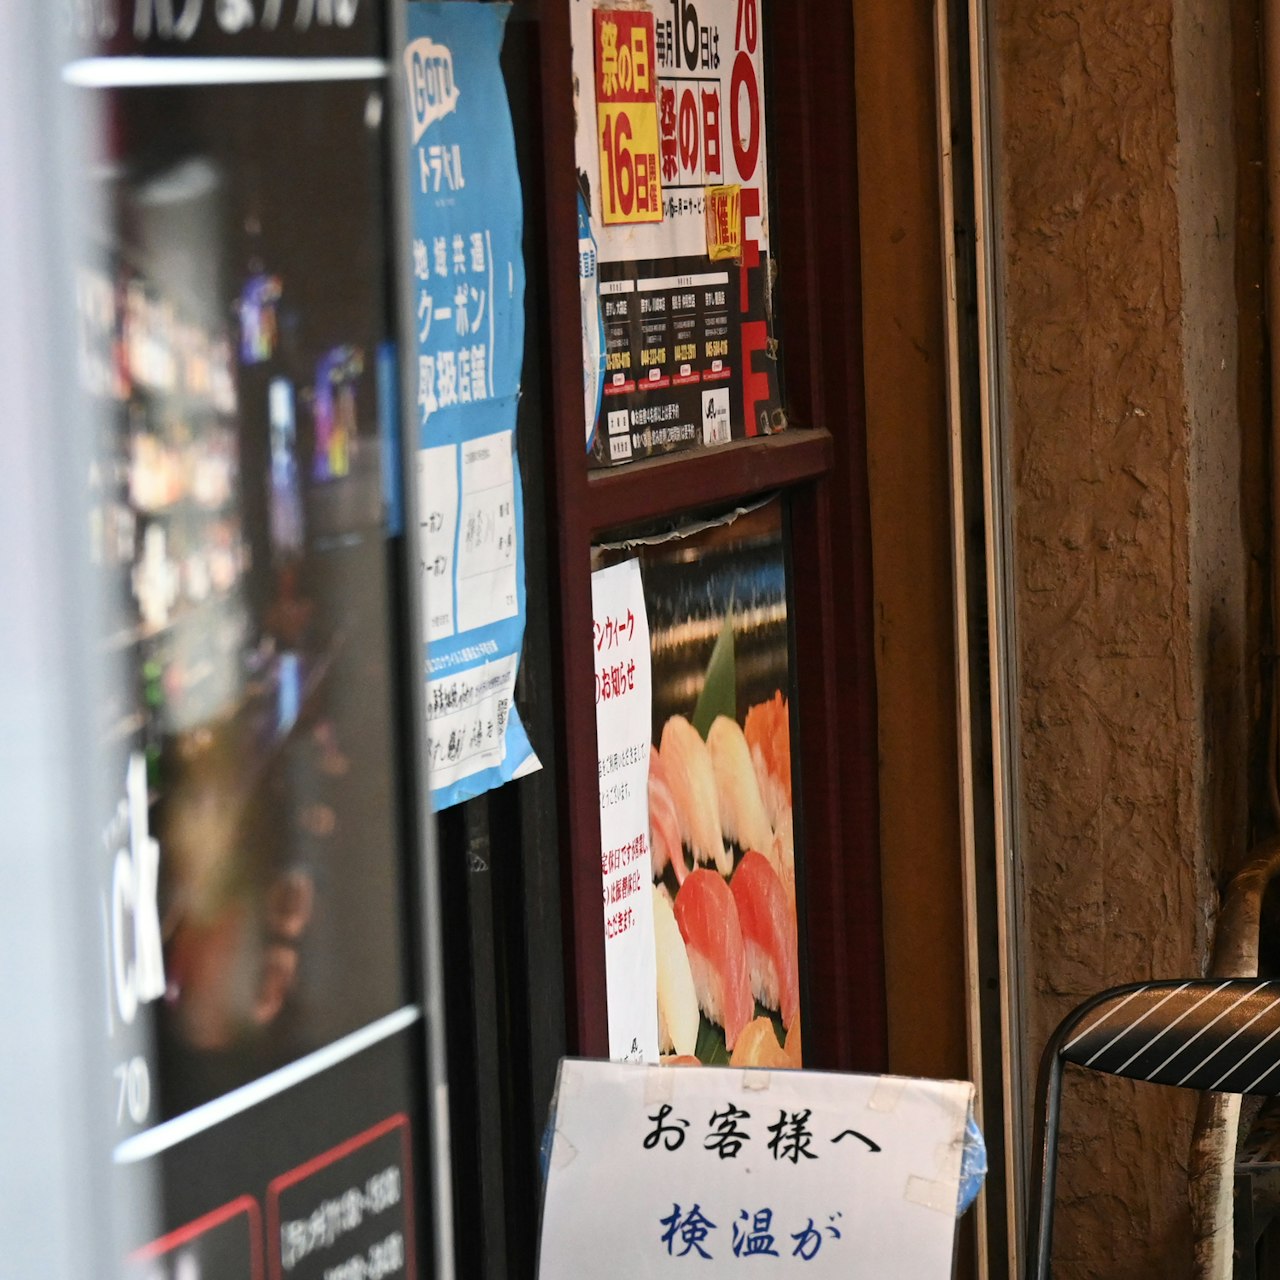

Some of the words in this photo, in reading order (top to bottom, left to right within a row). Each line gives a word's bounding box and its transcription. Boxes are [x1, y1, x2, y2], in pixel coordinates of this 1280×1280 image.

[601, 20, 649, 97] 祭の日
[603, 111, 649, 216] 16日
[661, 85, 721, 182] 祭の日
[418, 283, 486, 344] クーポン
[643, 1103, 883, 1166] お客様へ
[660, 1202, 842, 1261] 検温が
